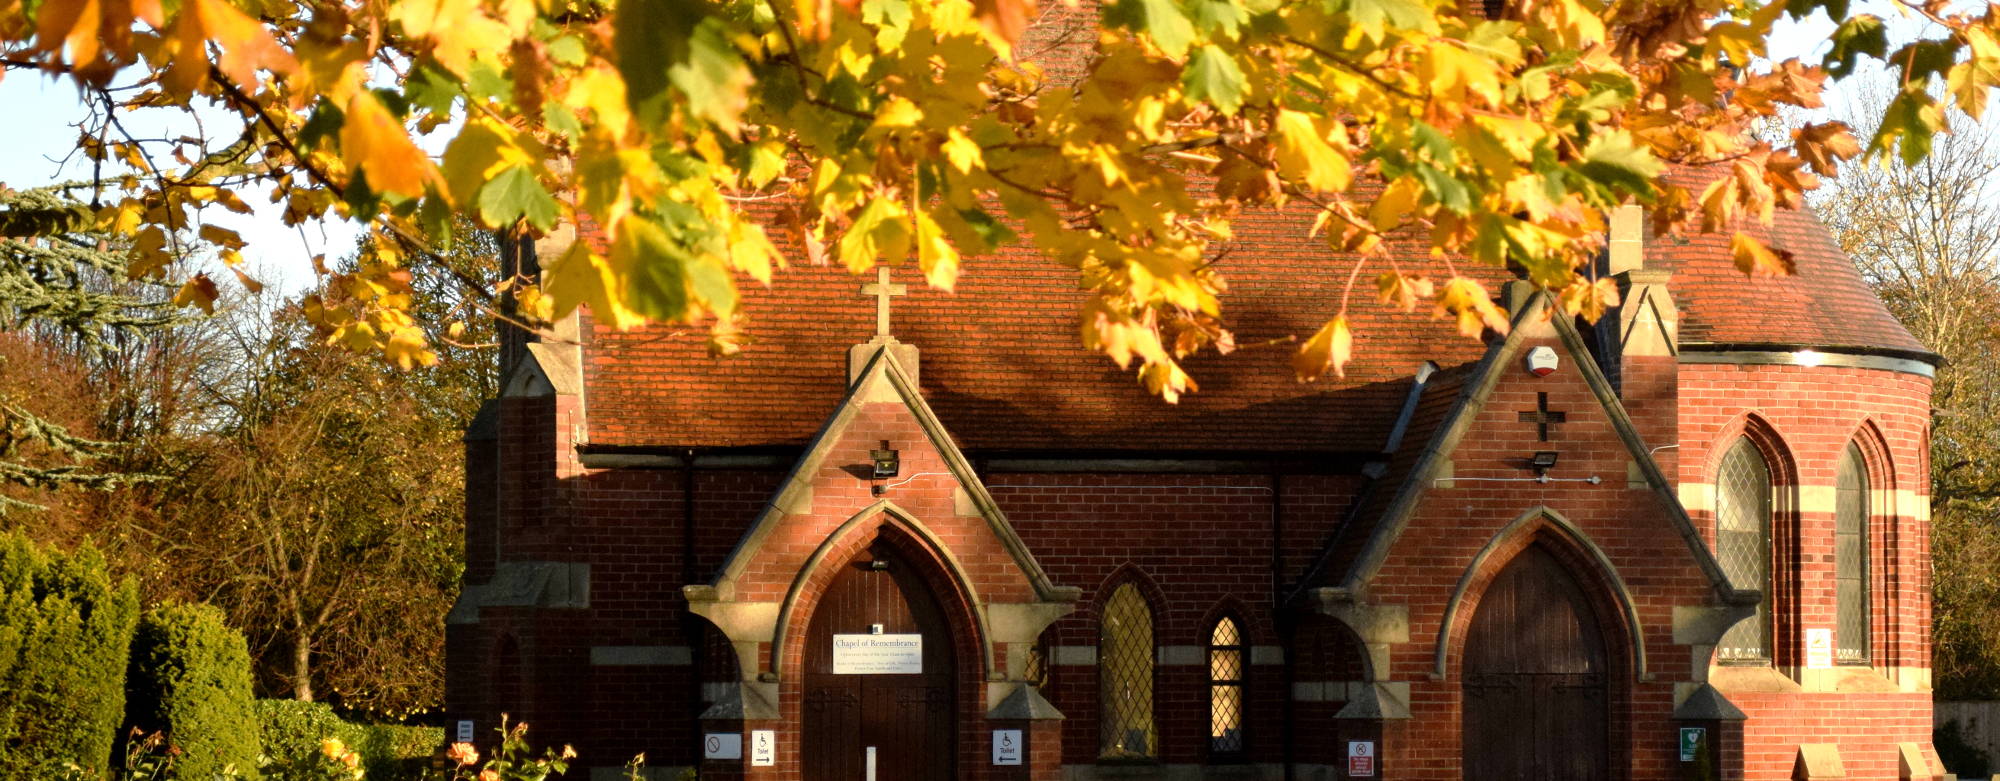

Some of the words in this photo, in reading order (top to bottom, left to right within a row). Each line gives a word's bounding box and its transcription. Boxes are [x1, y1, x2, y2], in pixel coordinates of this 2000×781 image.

[835, 639, 860, 650] Chapel
[862, 639, 869, 647] of
[870, 639, 918, 647] Remembrance
